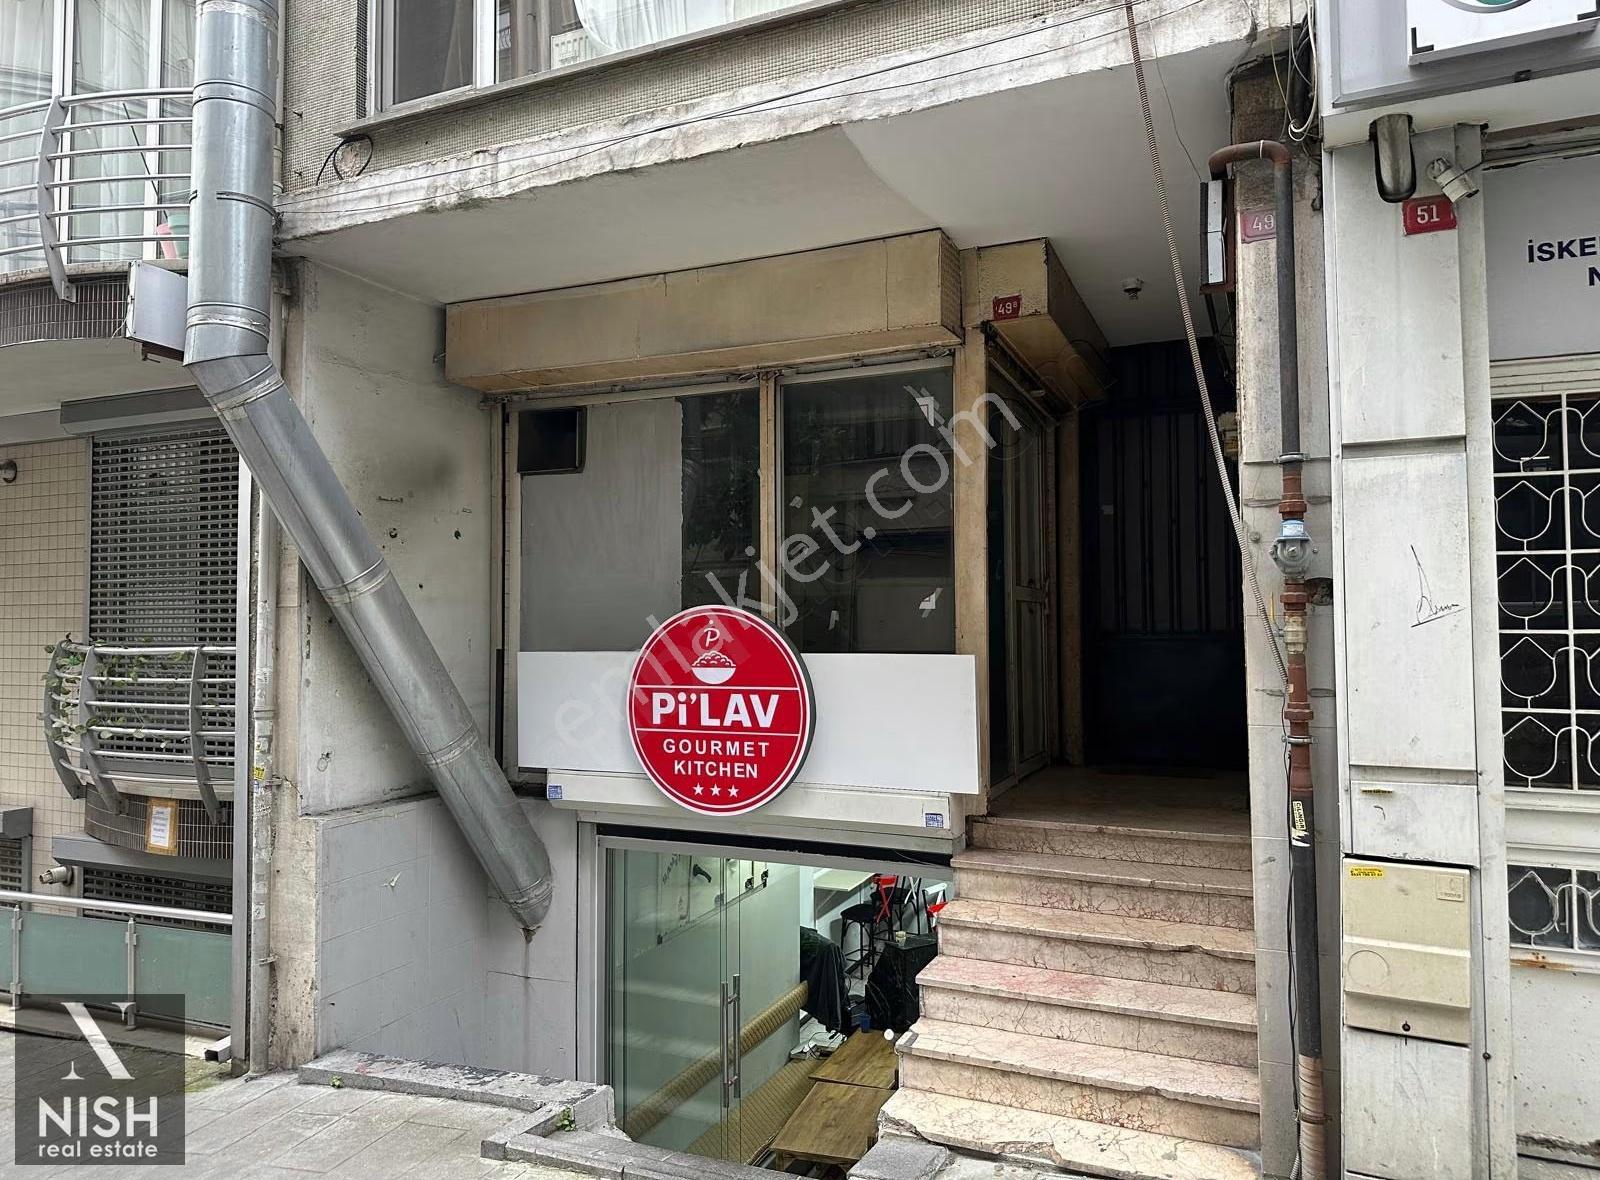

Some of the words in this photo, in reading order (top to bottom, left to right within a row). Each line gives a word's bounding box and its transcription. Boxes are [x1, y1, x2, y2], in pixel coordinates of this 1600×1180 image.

[1252, 214, 1275, 231] 49
[1417, 205, 1440, 224] 51
[1528, 237, 1600, 263] İSKE
[663, 738, 769, 757] GOURMET
[674, 760, 758, 778] KITCHEN
